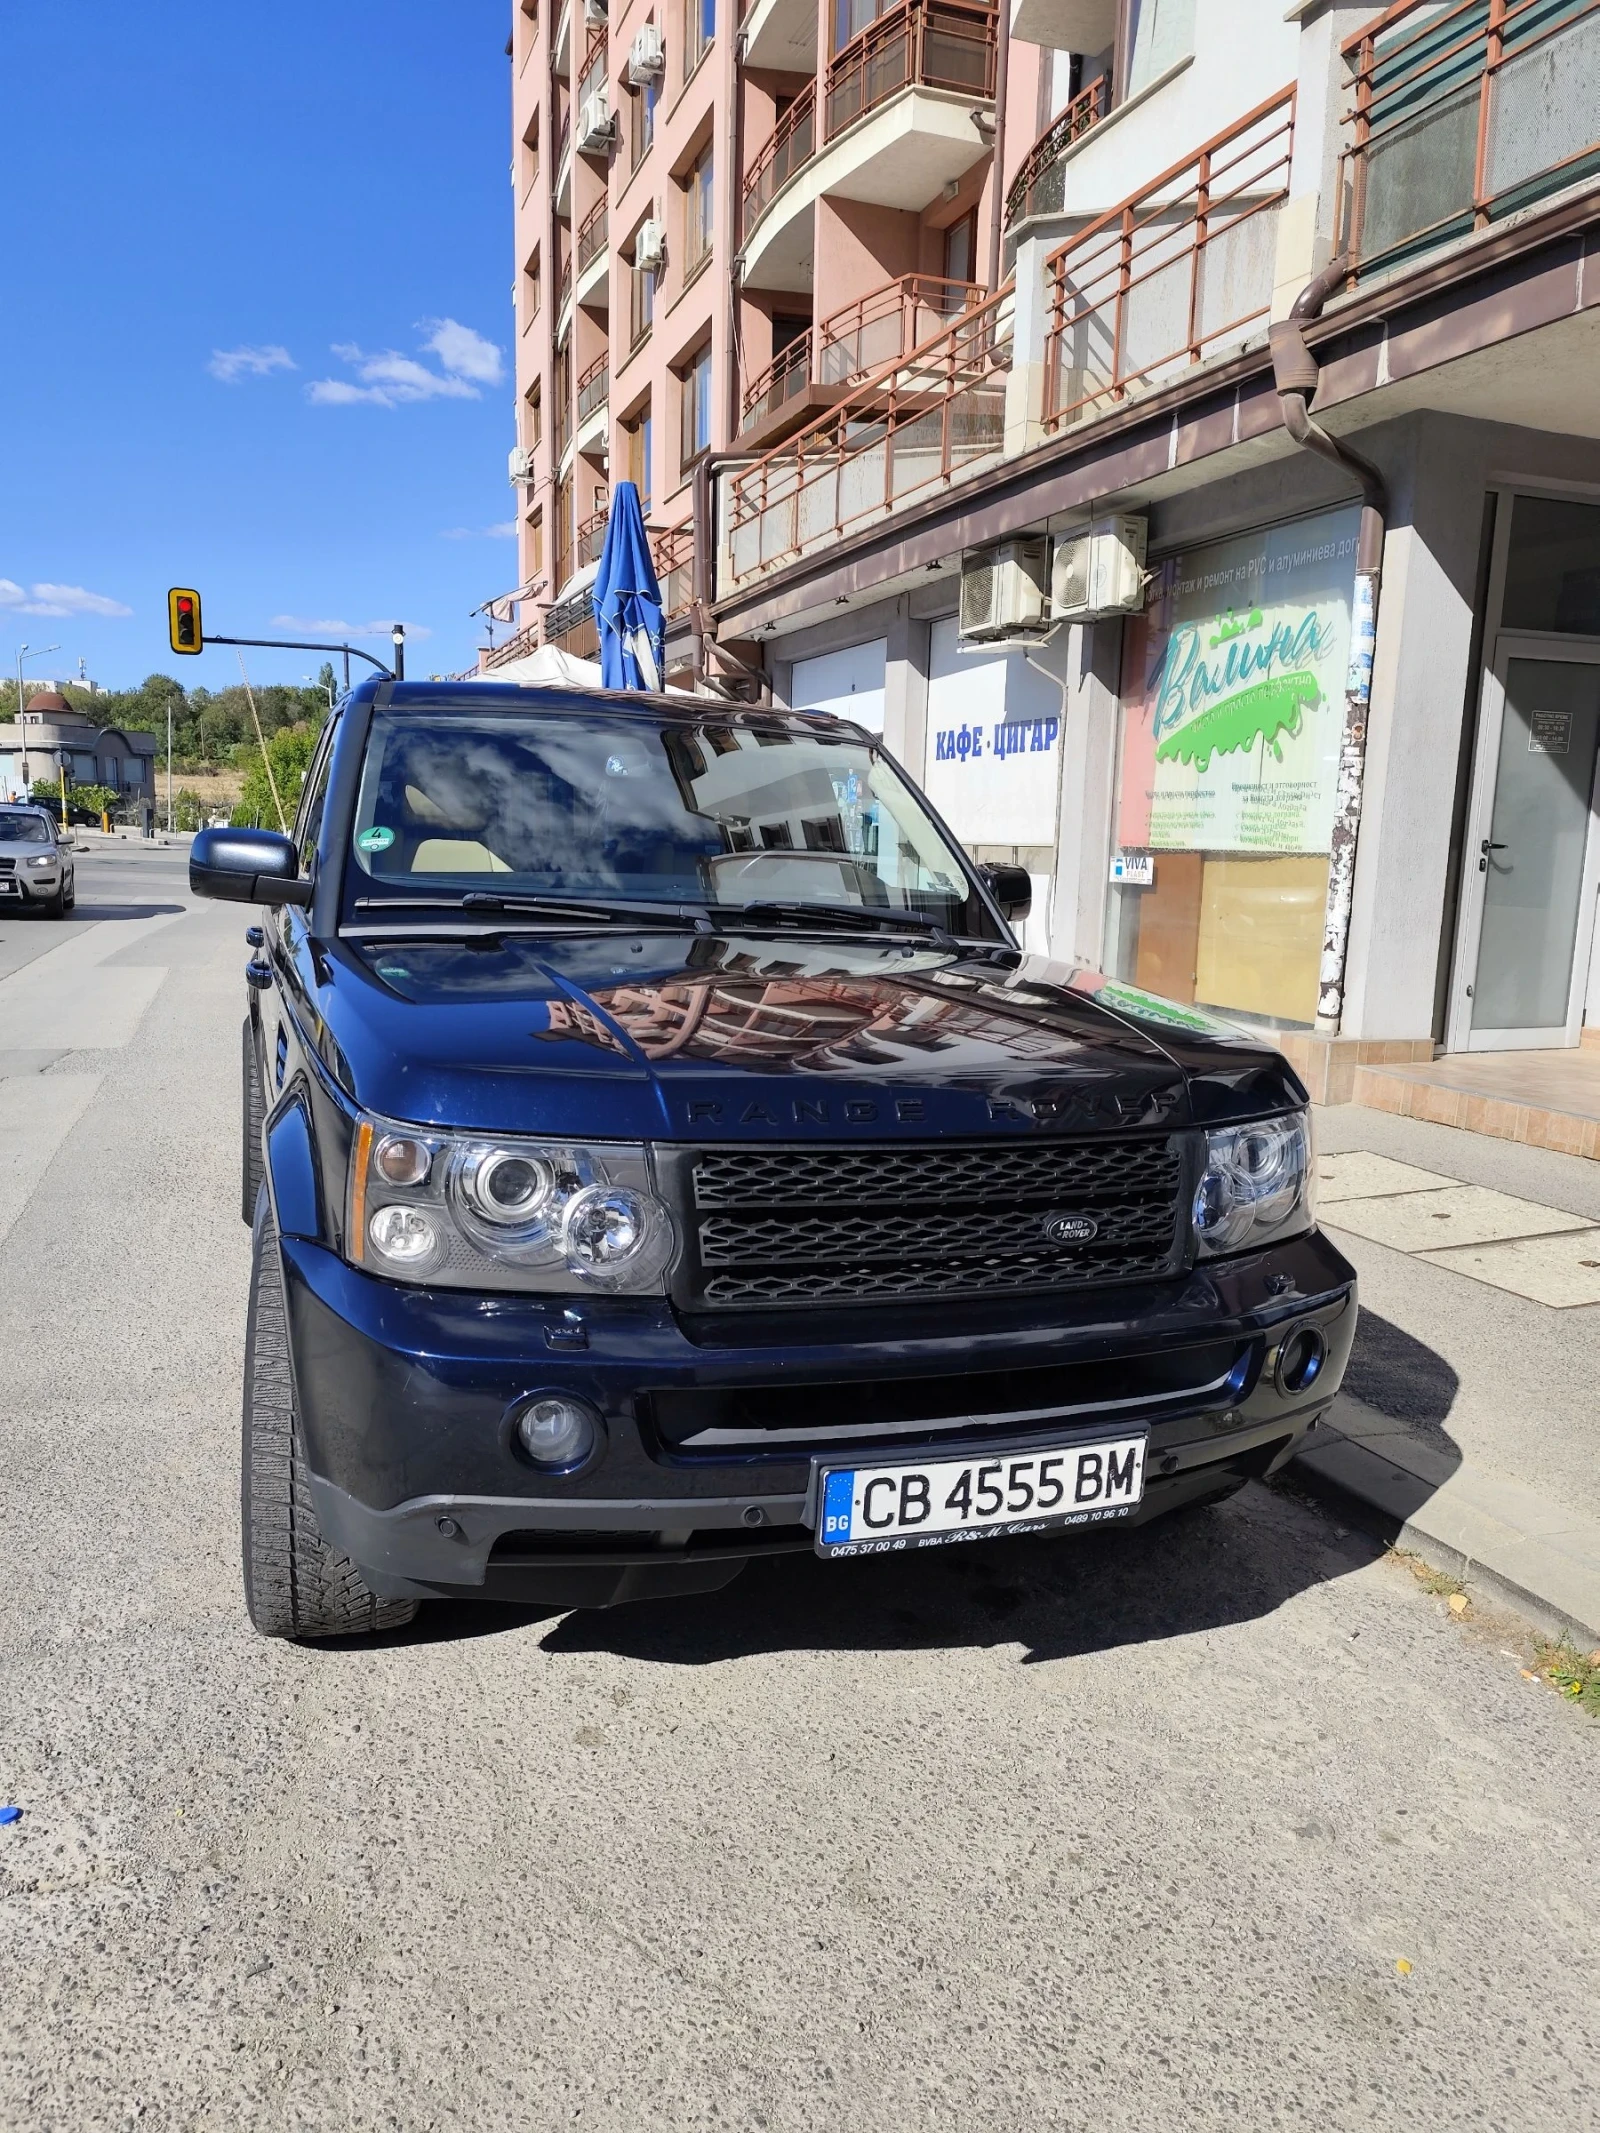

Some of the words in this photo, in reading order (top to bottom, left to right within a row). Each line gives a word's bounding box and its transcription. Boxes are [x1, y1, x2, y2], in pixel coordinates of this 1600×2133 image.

[1167, 579, 1195, 597] монтаж
[1197, 576, 1202, 590] и
[1204, 569, 1233, 593] ремонт
[1235, 566, 1246, 580] на
[1248, 556, 1266, 578] PVC
[1268, 559, 1275, 572] и
[1276, 542, 1336, 574] алуминиева
[1337, 537, 1359, 560] дог
[935, 723, 983, 762] КАФЕ
[993, 717, 1060, 760] ЦИГАР
[371, 827, 381, 839] 4
[1125, 857, 1148, 870] VIVA
[687, 1098, 928, 1124] RANGE
[987, 1091, 1184, 1122] ROVER
[863, 1474, 931, 1529] CB
[945, 1457, 1064, 1520] 4555
[1075, 1447, 1136, 1504] BM
[826, 1515, 849, 1533] BG
[830, 1545, 858, 1557] 0475
[860, 1543, 873, 1554] 37
[876, 1541, 890, 1552] 00
[892, 1539, 906, 1550] 49
[918, 1537, 943, 1548] BVBA
[945, 1526, 1002, 1544] R&M
[1006, 1522, 1050, 1535] Cars
[1064, 1514, 1088, 1526] 0489
[1091, 1512, 1101, 1523] 10
[1102, 1510, 1115, 1520] 96
[1117, 1507, 1129, 1518] 10
